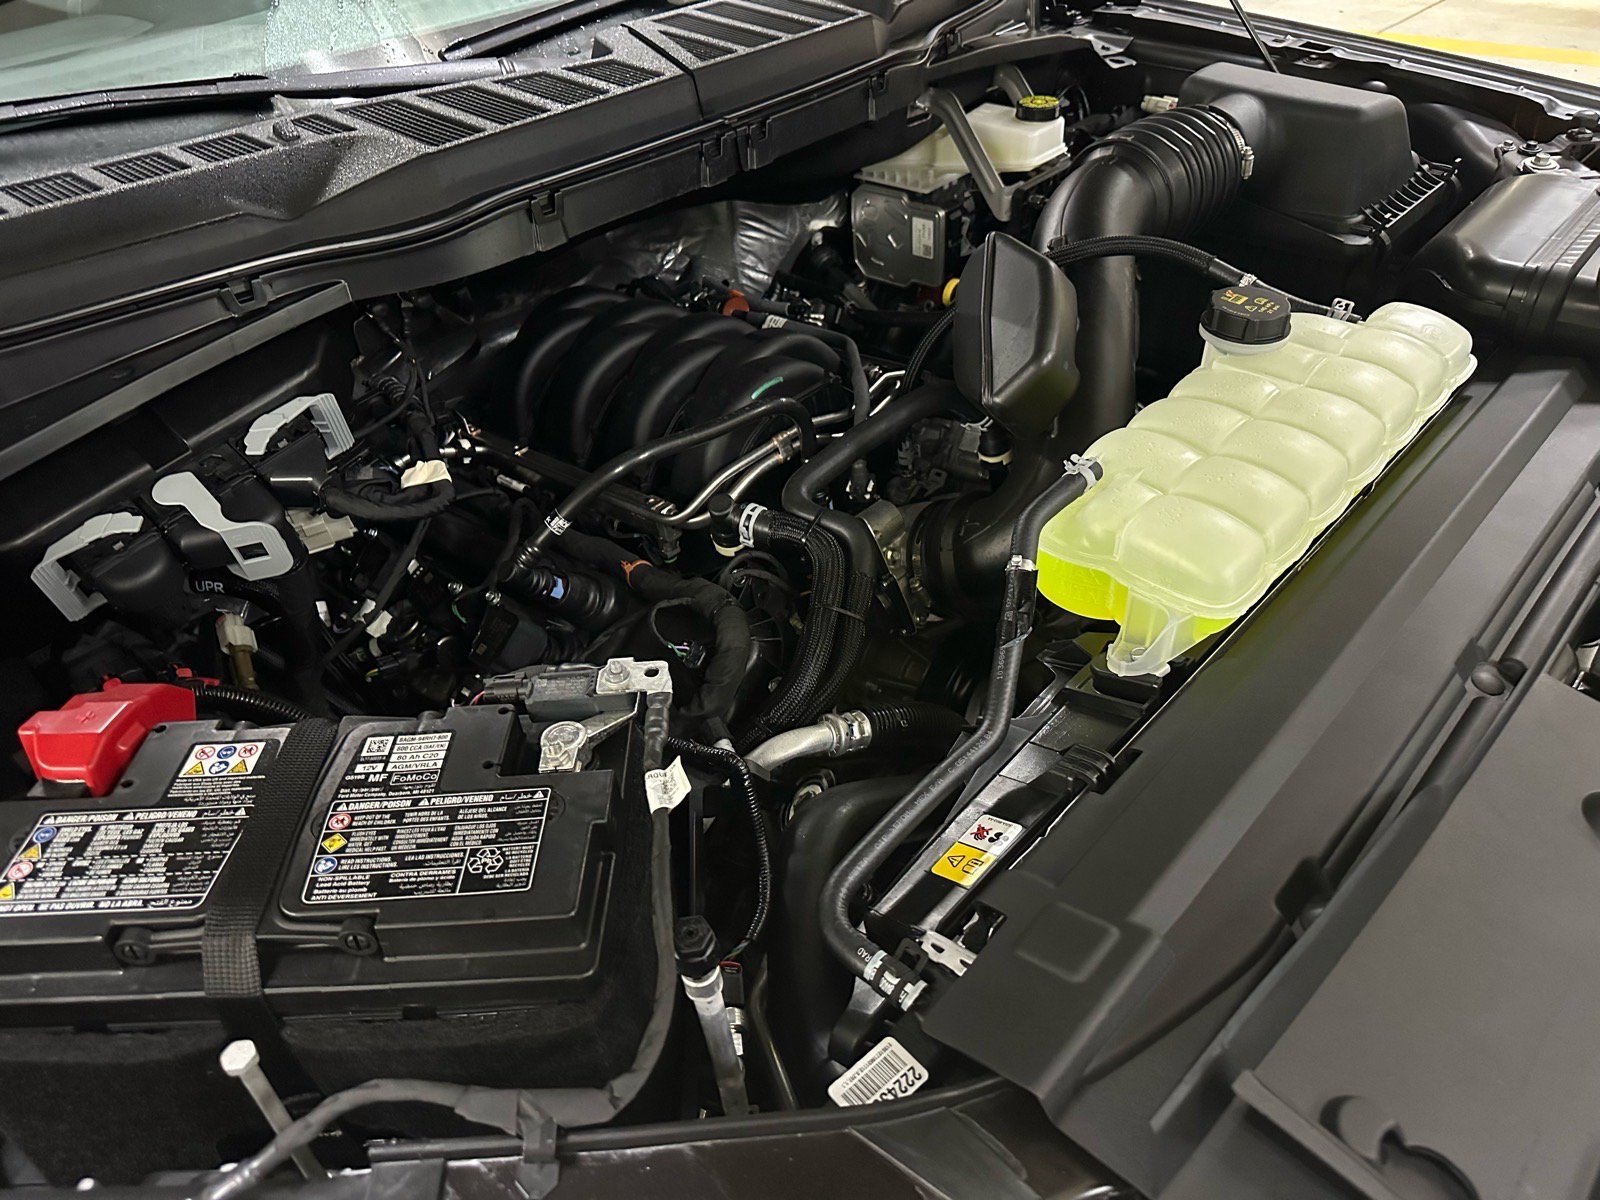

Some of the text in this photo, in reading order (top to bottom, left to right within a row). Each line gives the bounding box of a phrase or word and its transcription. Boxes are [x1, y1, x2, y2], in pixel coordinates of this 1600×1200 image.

[196, 580, 225, 594] UPR
[368, 774, 388, 782] MF
[392, 772, 438, 782] FoMoCo
[348, 800, 412, 810] DANGER/POISON
[430, 794, 494, 806] PELIGRO/VENENO
[56, 814, 119, 824] DANGER/POISON
[135, 810, 198, 820] PELIGRO/VENENO
[858, 947, 873, 962] RAD
